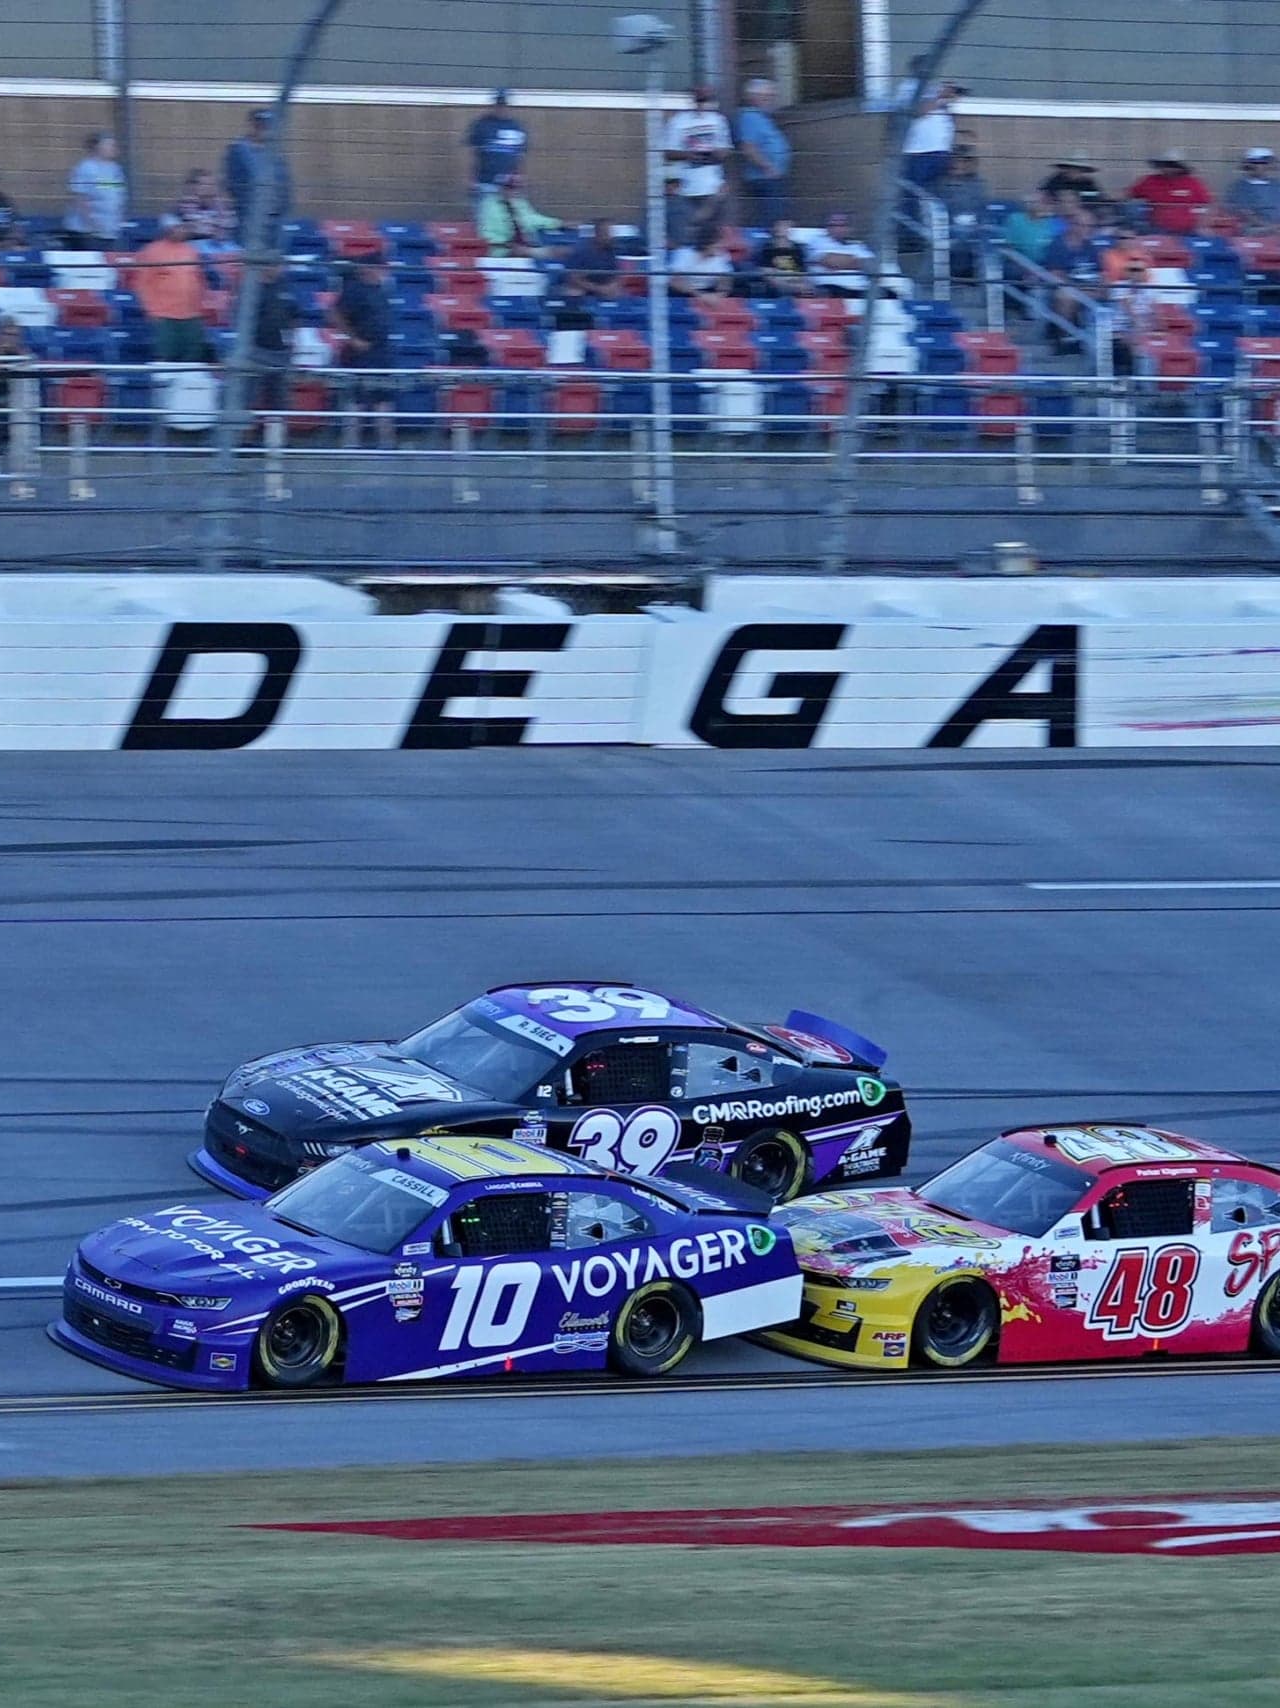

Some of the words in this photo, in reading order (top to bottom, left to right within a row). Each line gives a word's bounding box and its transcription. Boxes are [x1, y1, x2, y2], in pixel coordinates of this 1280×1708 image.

[527, 986, 673, 1024] 39
[530, 1026, 558, 1043] SIEG
[537, 1085, 553, 1098] 12
[372, 1136, 575, 1181] 10
[569, 1105, 683, 1178] 39
[1040, 1126, 1196, 1164] 48
[391, 1175, 436, 1198] CASSILL
[154, 1204, 319, 1275] VOYAGER
[183, 1238, 226, 1261] FOR
[388, 1280, 413, 1290] Mobil
[550, 1228, 748, 1304] VOYAGER
[75, 1277, 143, 1315] CAMARO
[277, 1276, 336, 1295] GOODYEAR
[1088, 1241, 1202, 1338] 48
[437, 1260, 543, 1352] 10
[872, 1332, 907, 1341] ARP
